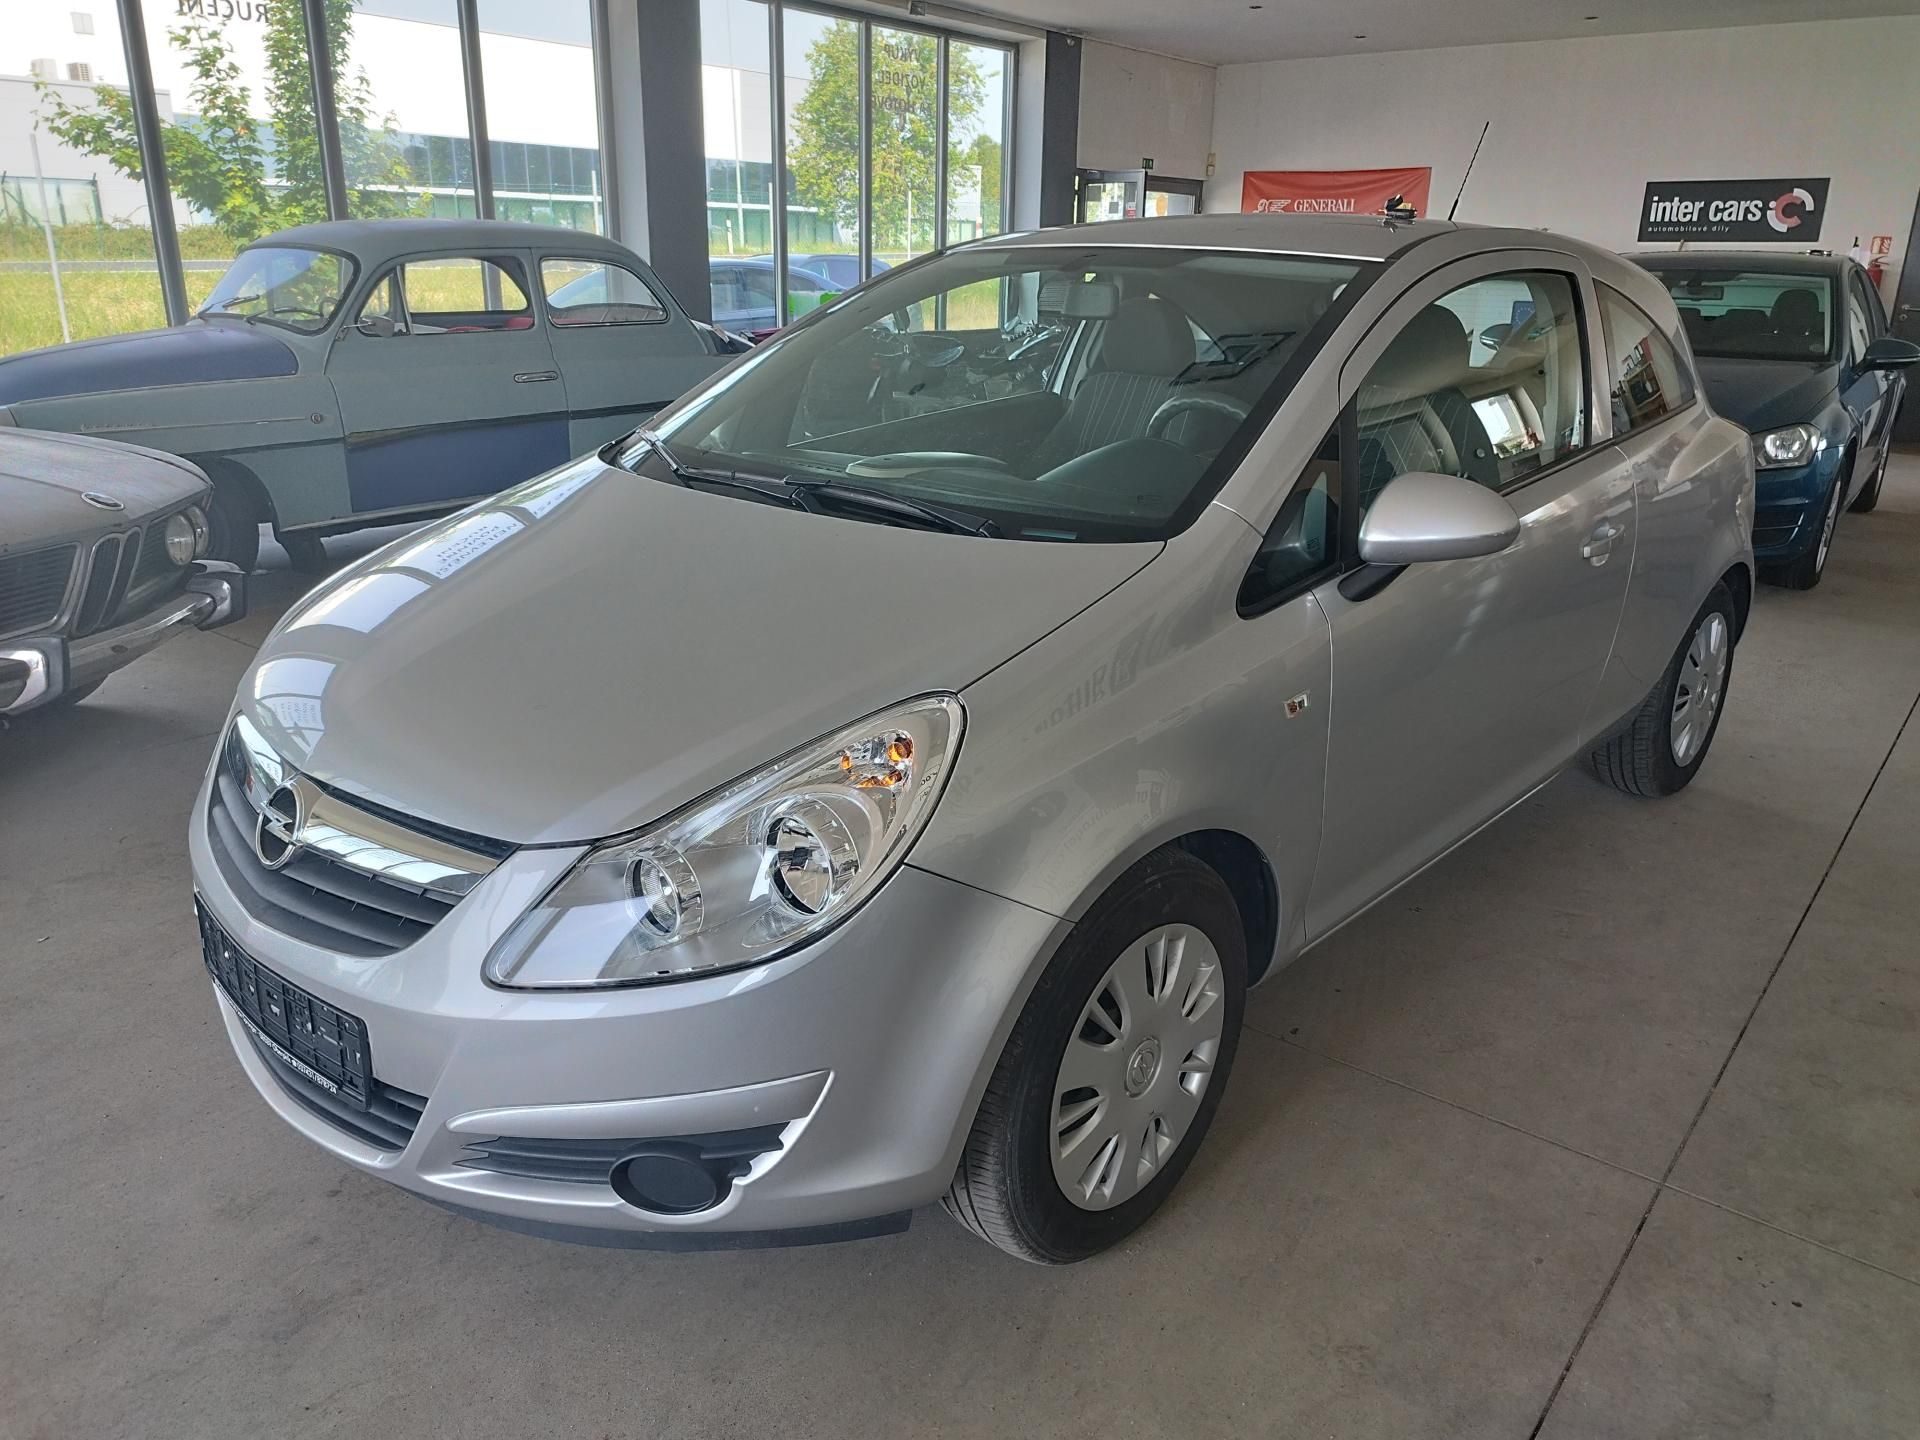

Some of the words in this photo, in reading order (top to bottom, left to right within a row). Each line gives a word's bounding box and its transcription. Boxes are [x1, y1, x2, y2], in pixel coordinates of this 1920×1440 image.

[1294, 198, 1355, 214] GENERALI
[1649, 195, 1705, 222] inter
[1708, 199, 1763, 222] cars
